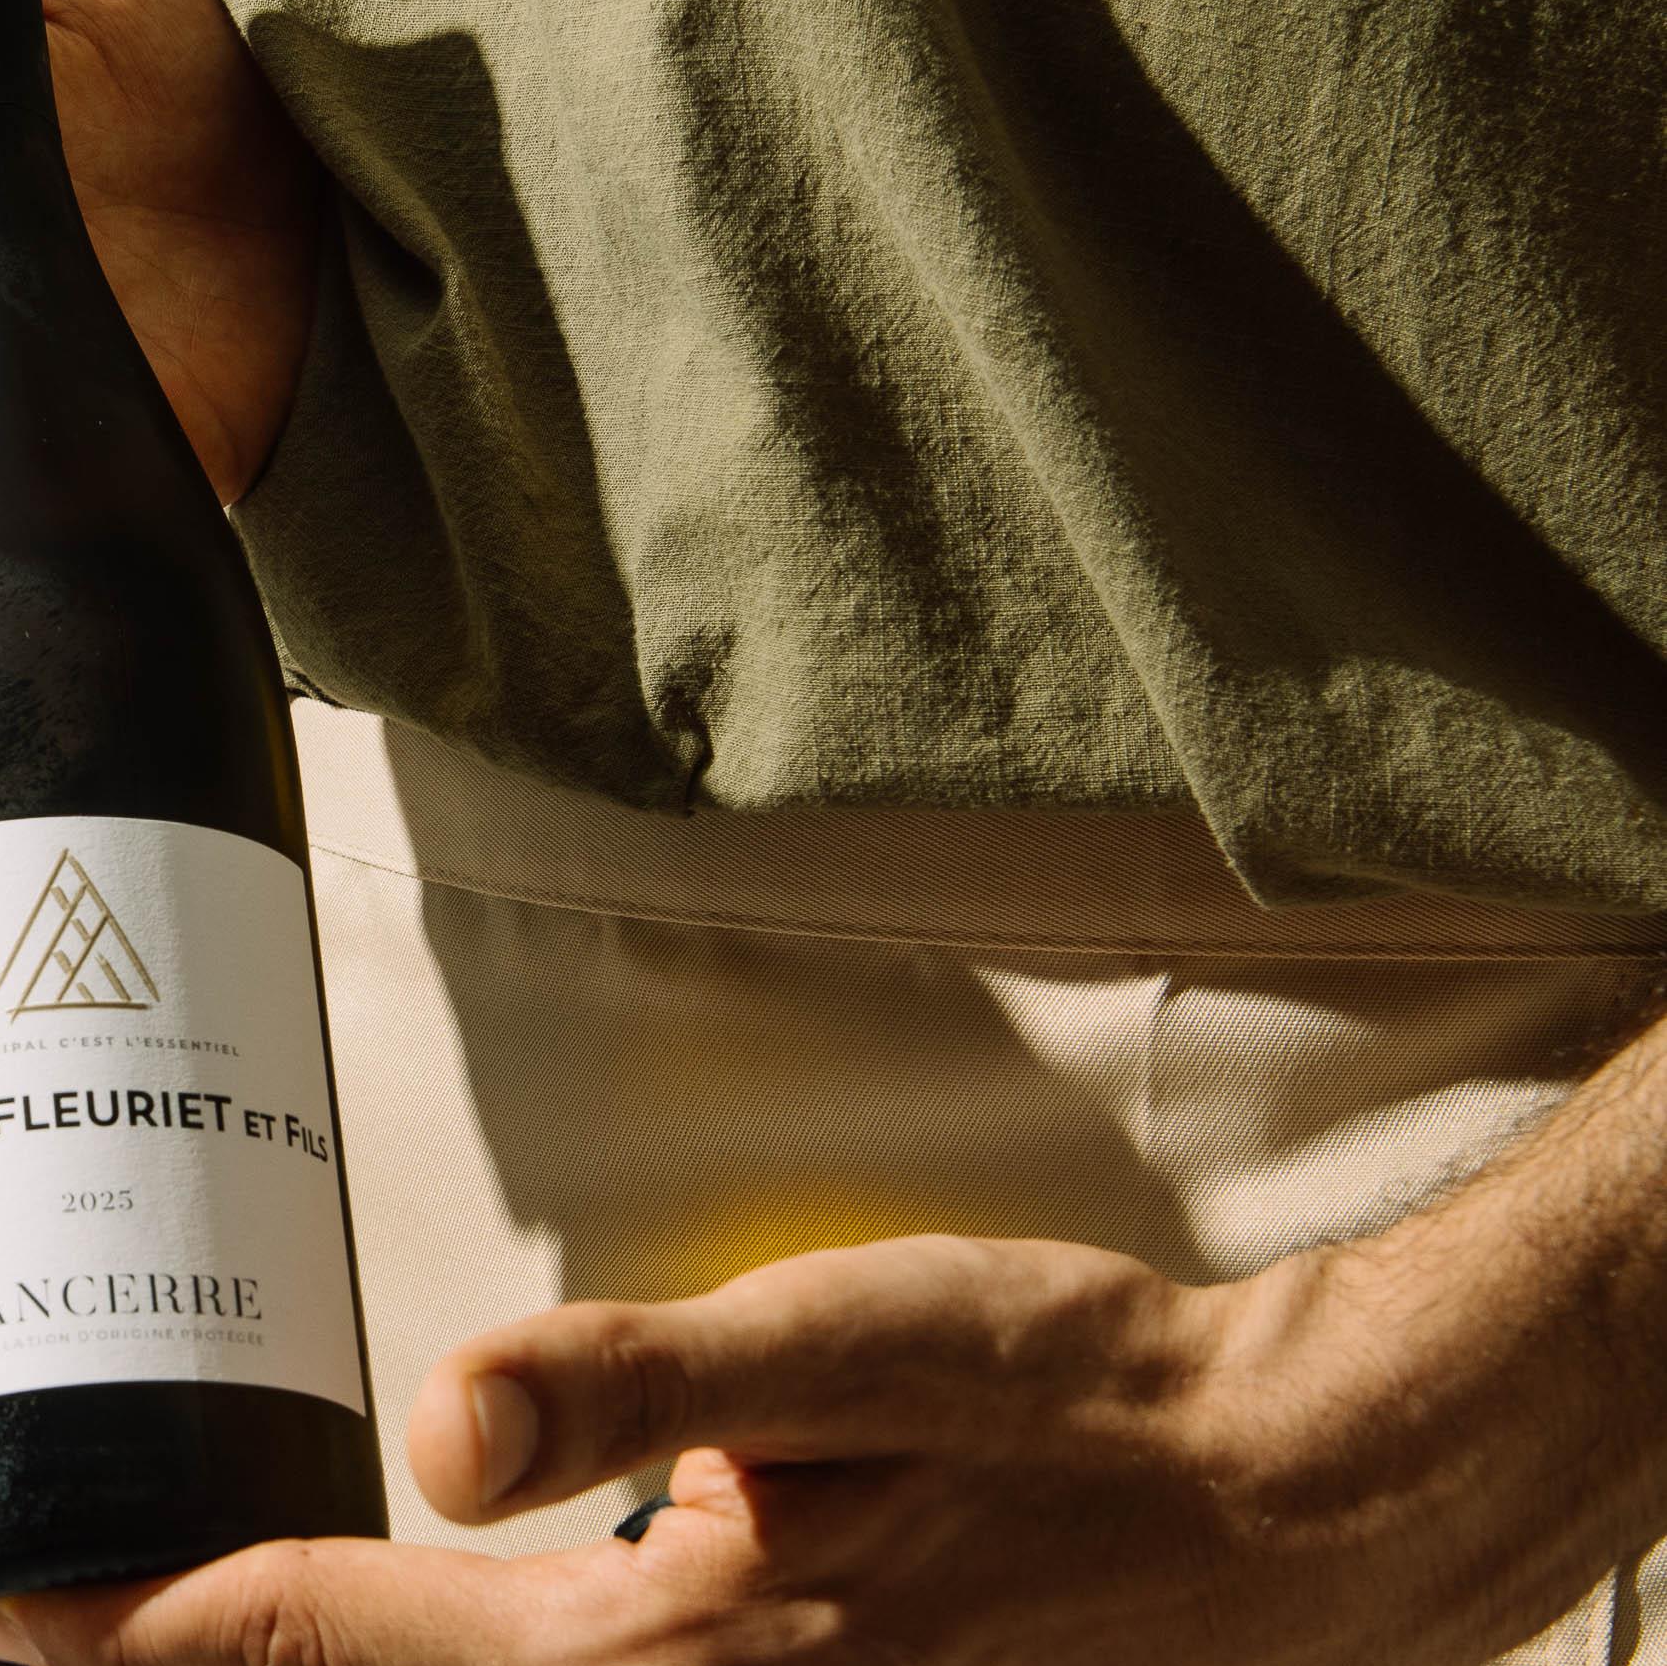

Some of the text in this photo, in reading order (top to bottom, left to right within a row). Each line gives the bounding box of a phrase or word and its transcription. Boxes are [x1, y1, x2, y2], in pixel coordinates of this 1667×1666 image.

[59, 1035, 115, 1048] C'EST
[126, 1035, 241, 1057] L'ESSENTIEL
[243, 1110, 276, 1142] ET
[285, 1113, 329, 1163] FILS
[61, 1188, 135, 1215] 2025
